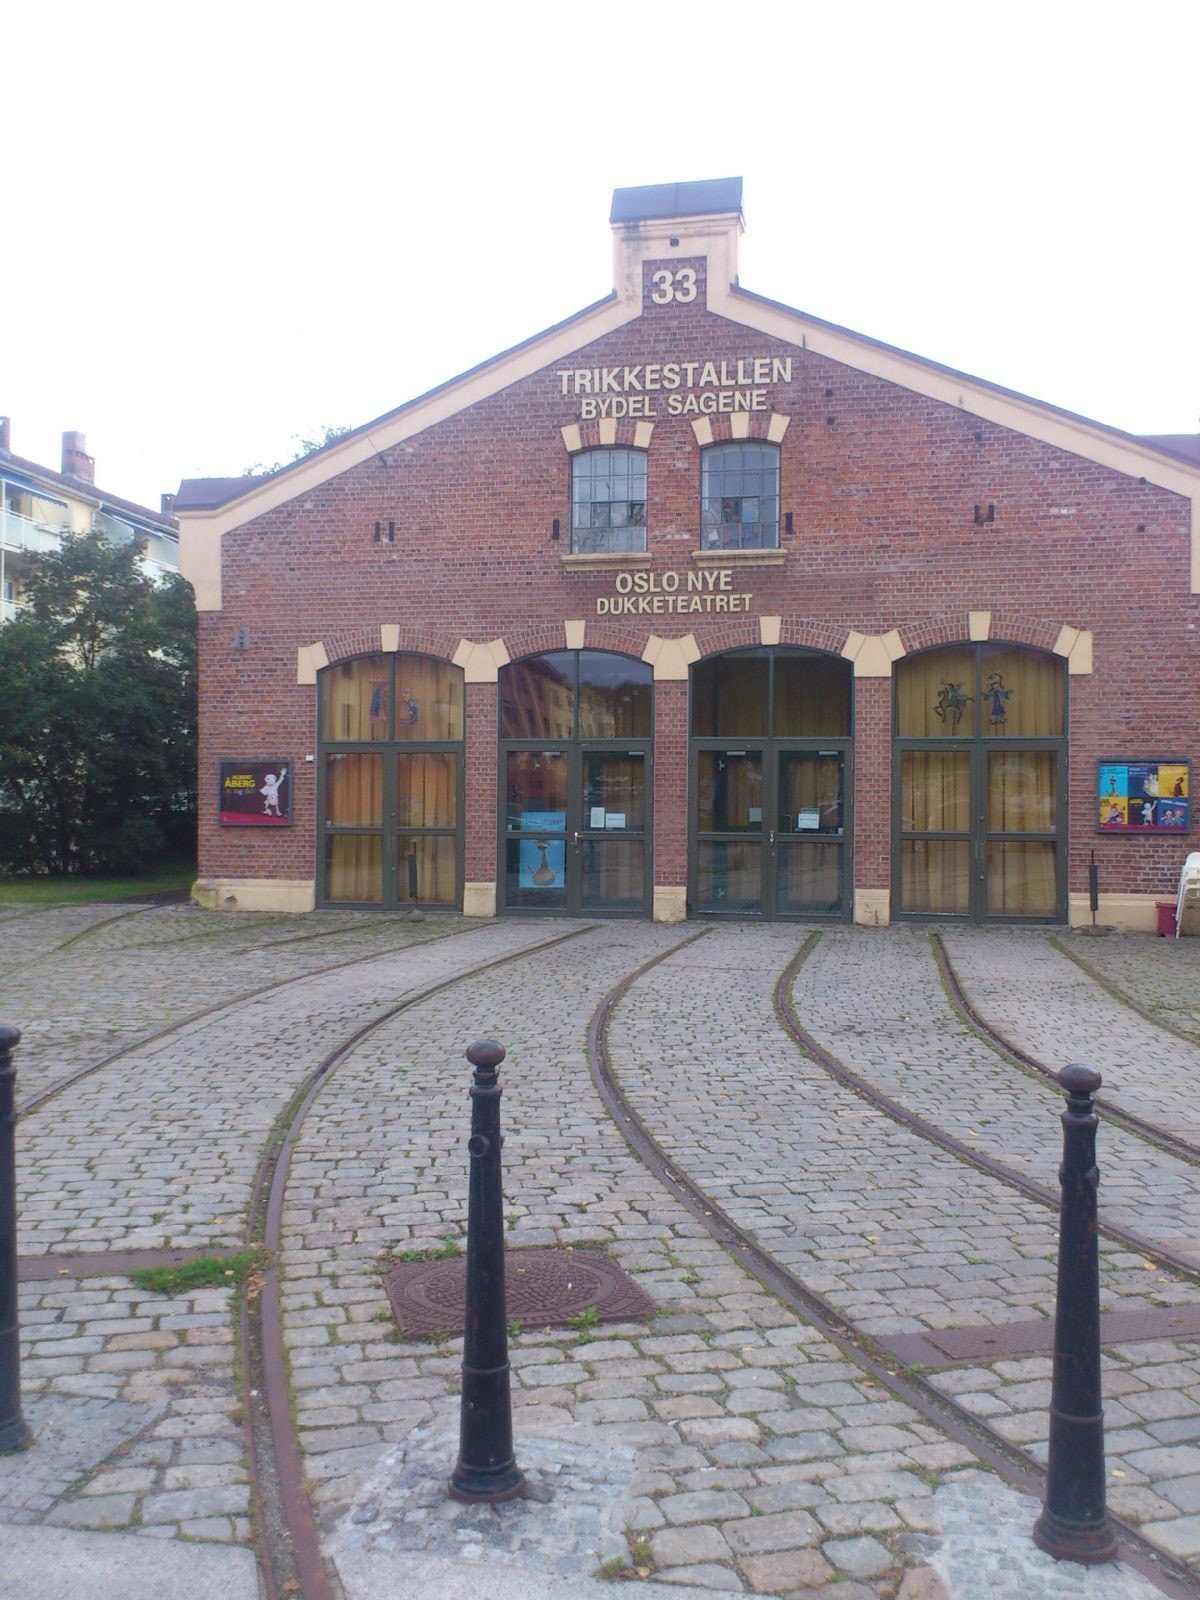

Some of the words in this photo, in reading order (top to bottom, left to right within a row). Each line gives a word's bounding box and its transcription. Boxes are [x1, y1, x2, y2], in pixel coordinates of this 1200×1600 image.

[651, 268, 698, 305] 33
[556, 357, 792, 395] TRIKKESTALLEN
[581, 396, 657, 420] BYDEL
[667, 389, 768, 415] SAGENE
[615, 571, 680, 594] OSLO
[687, 570, 733, 591] NYE
[596, 594, 753, 615] DUKKETEATRET
